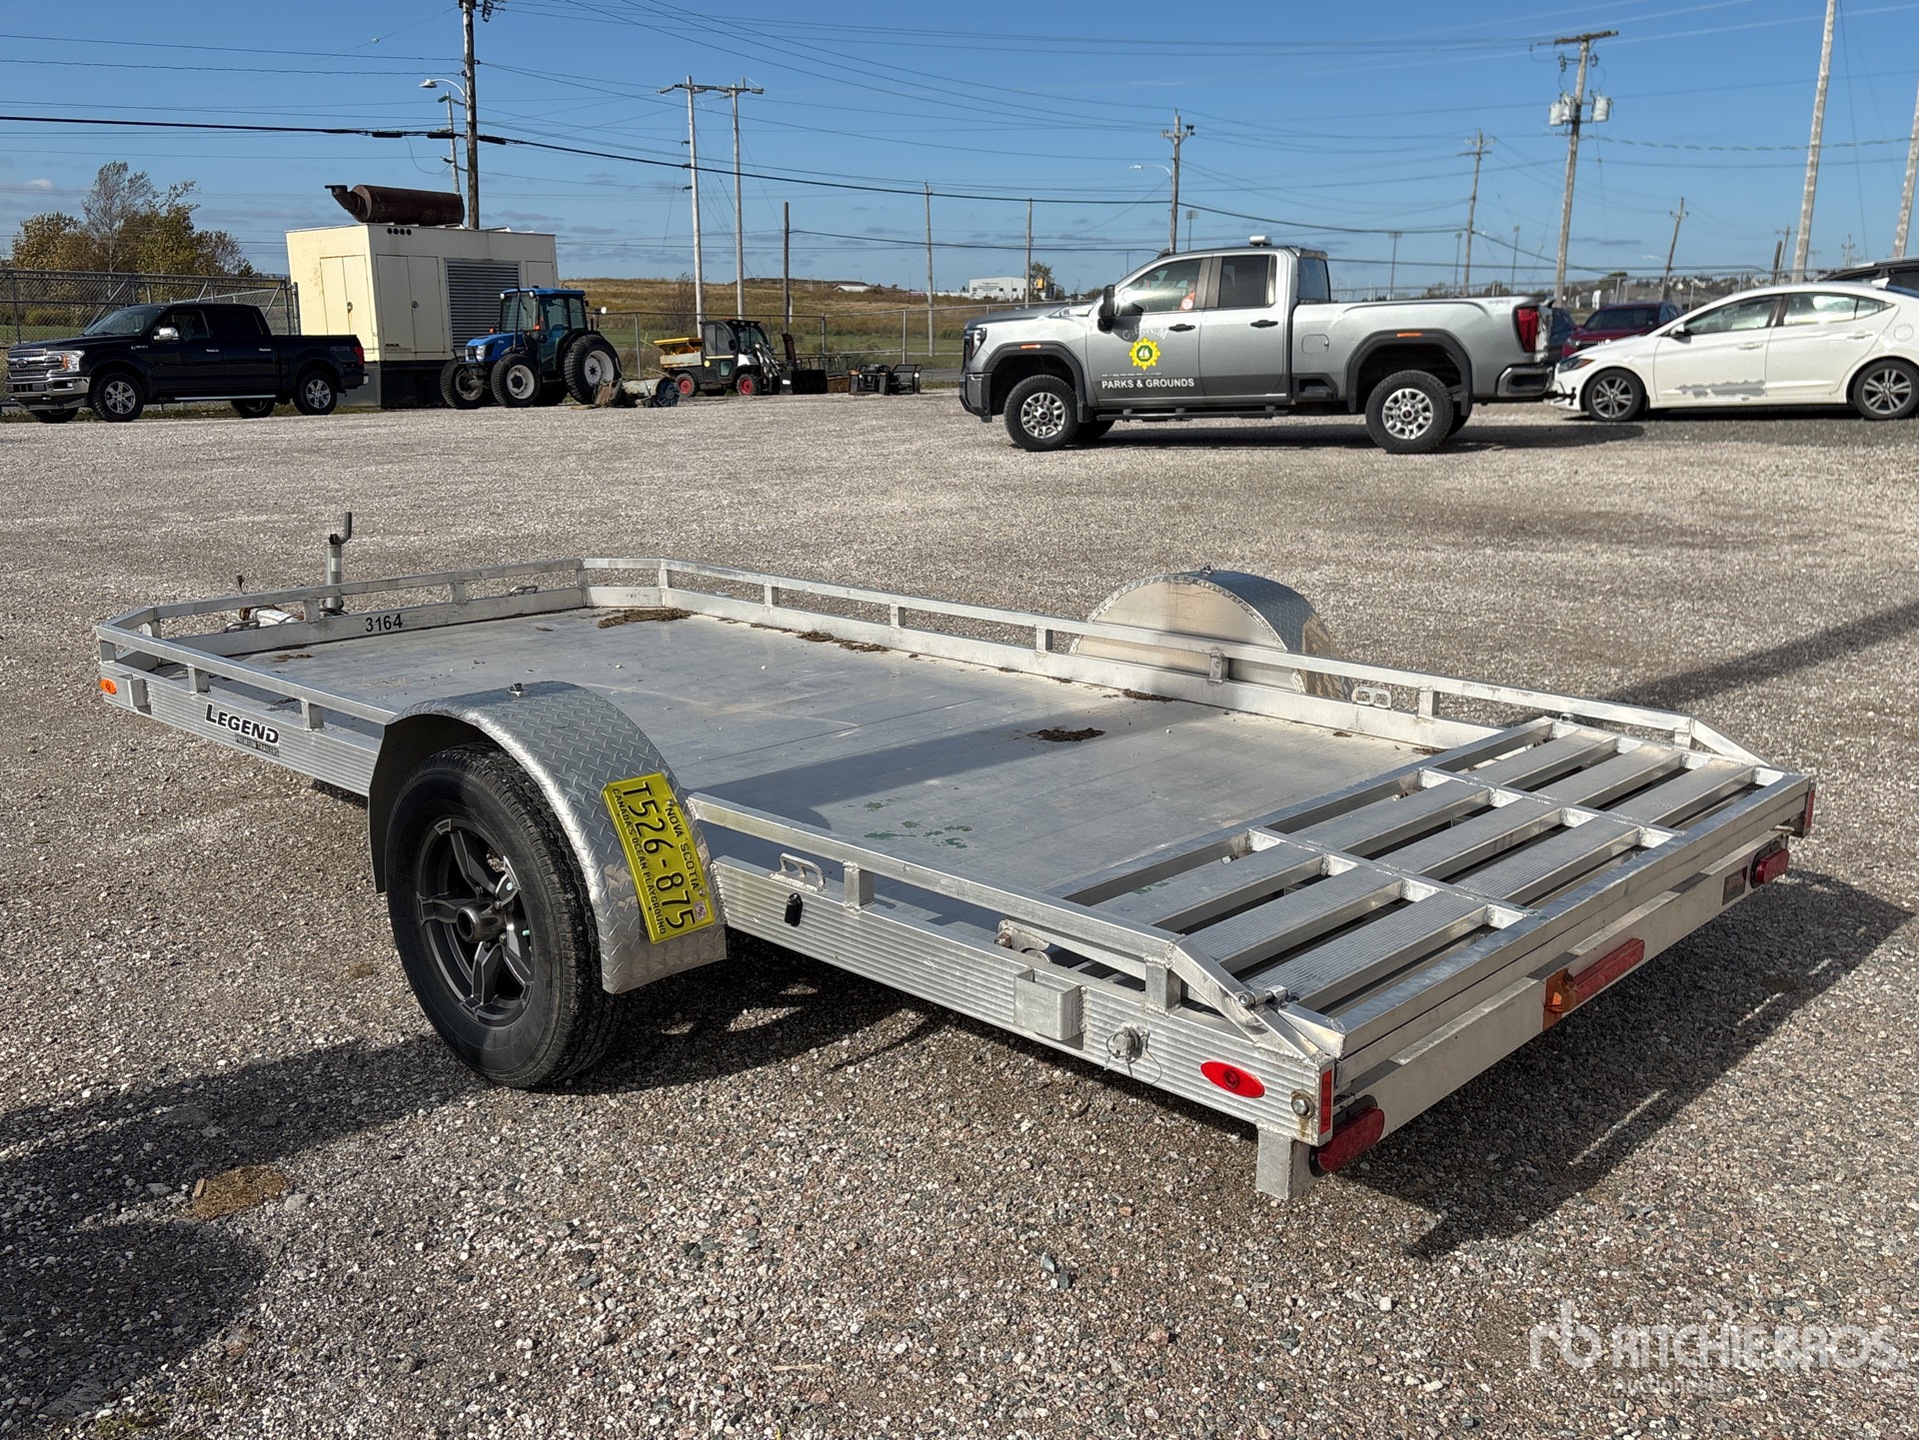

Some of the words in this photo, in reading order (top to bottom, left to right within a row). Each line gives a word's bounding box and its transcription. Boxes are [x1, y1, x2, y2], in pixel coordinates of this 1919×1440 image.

[1101, 379, 1134, 389] PARKS
[1136, 379, 1144, 388] &
[1145, 378, 1195, 388] GROUNDS
[365, 613, 403, 632] 3164
[205, 703, 280, 746] LEGEND
[612, 788, 636, 835] CANADA'S
[632, 835, 649, 870] OCEAN
[643, 871, 667, 935] PLAYGROUND
[622, 781, 696, 930] T526-875
[665, 807, 684, 838] NOVA
[679, 842, 700, 891] SCOTIA
